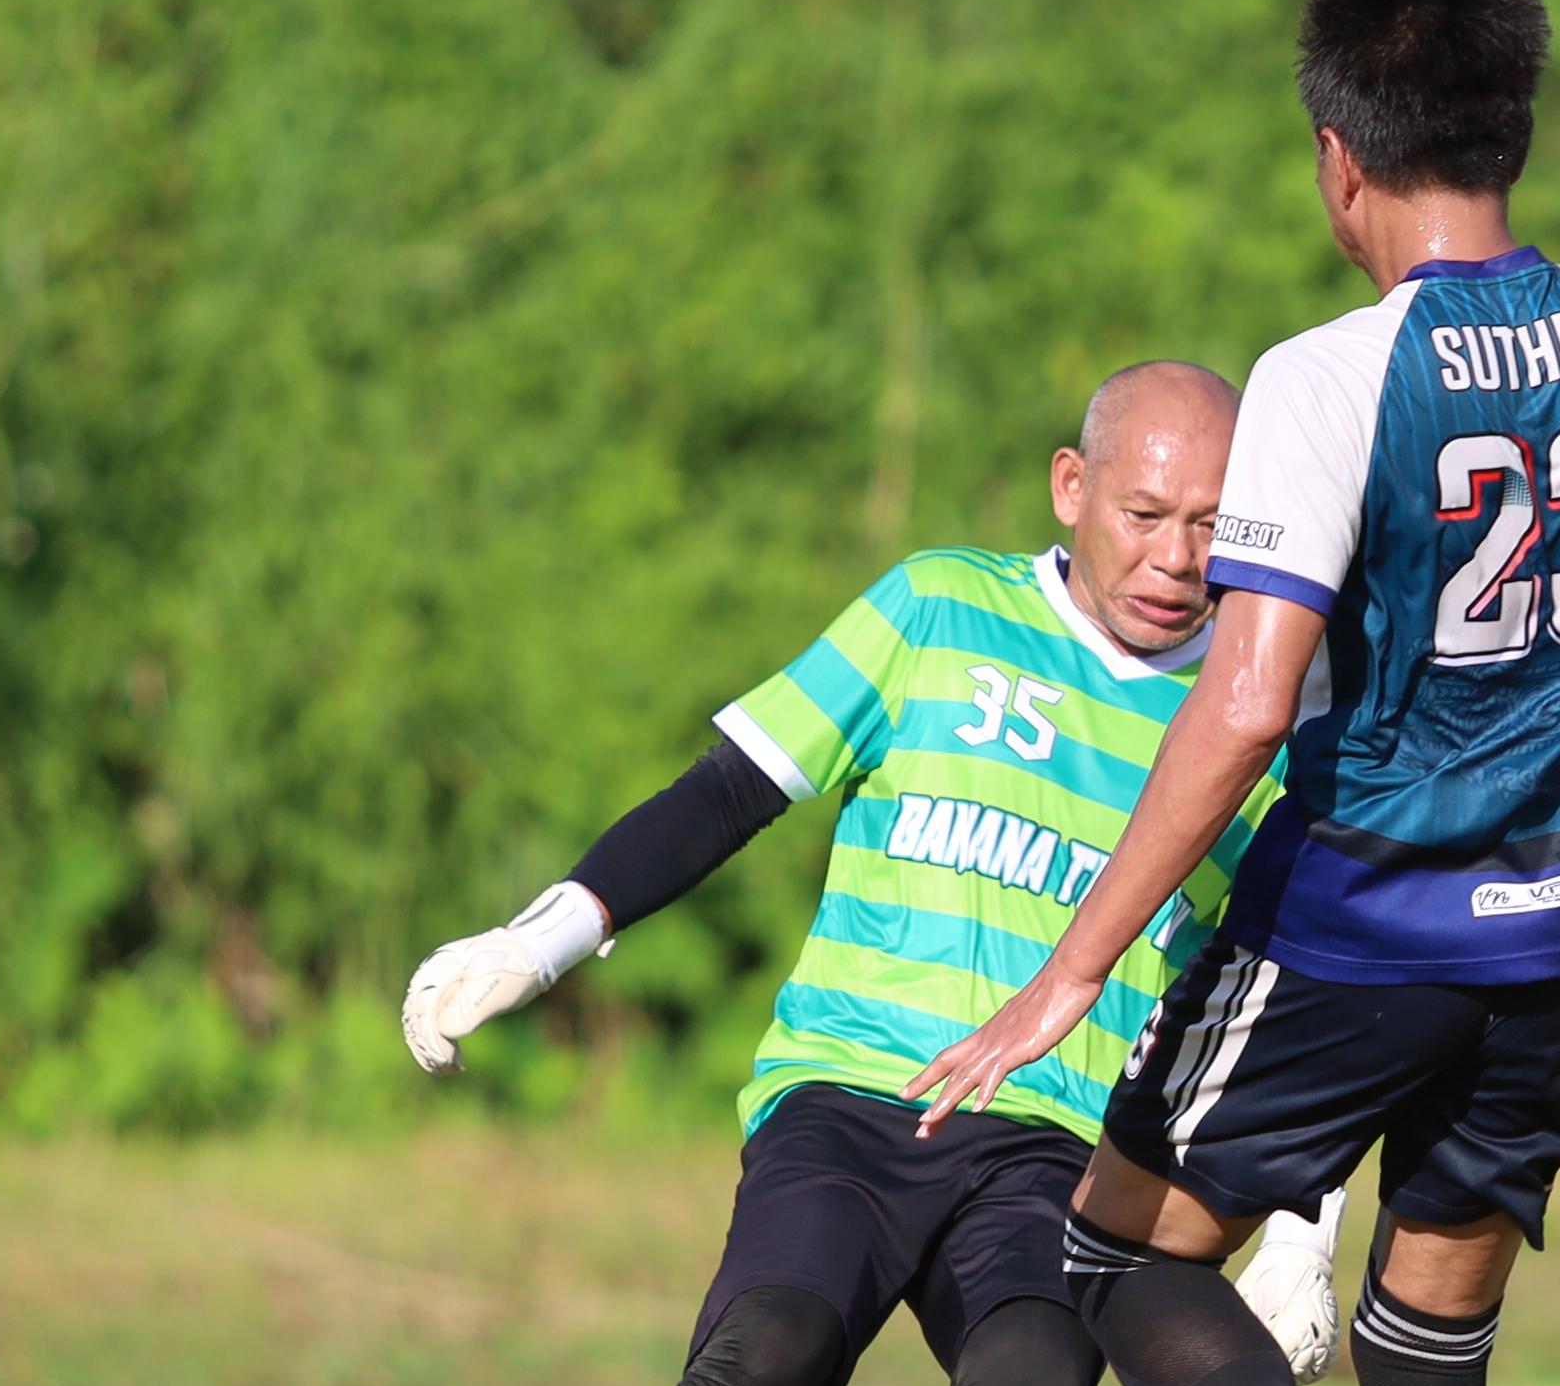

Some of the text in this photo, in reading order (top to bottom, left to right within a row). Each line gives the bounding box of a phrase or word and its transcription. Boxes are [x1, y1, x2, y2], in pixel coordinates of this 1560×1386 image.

[1212, 513, 1285, 551] MAESOT
[952, 663, 1065, 762] 35
[885, 791, 1061, 897] BANANA
